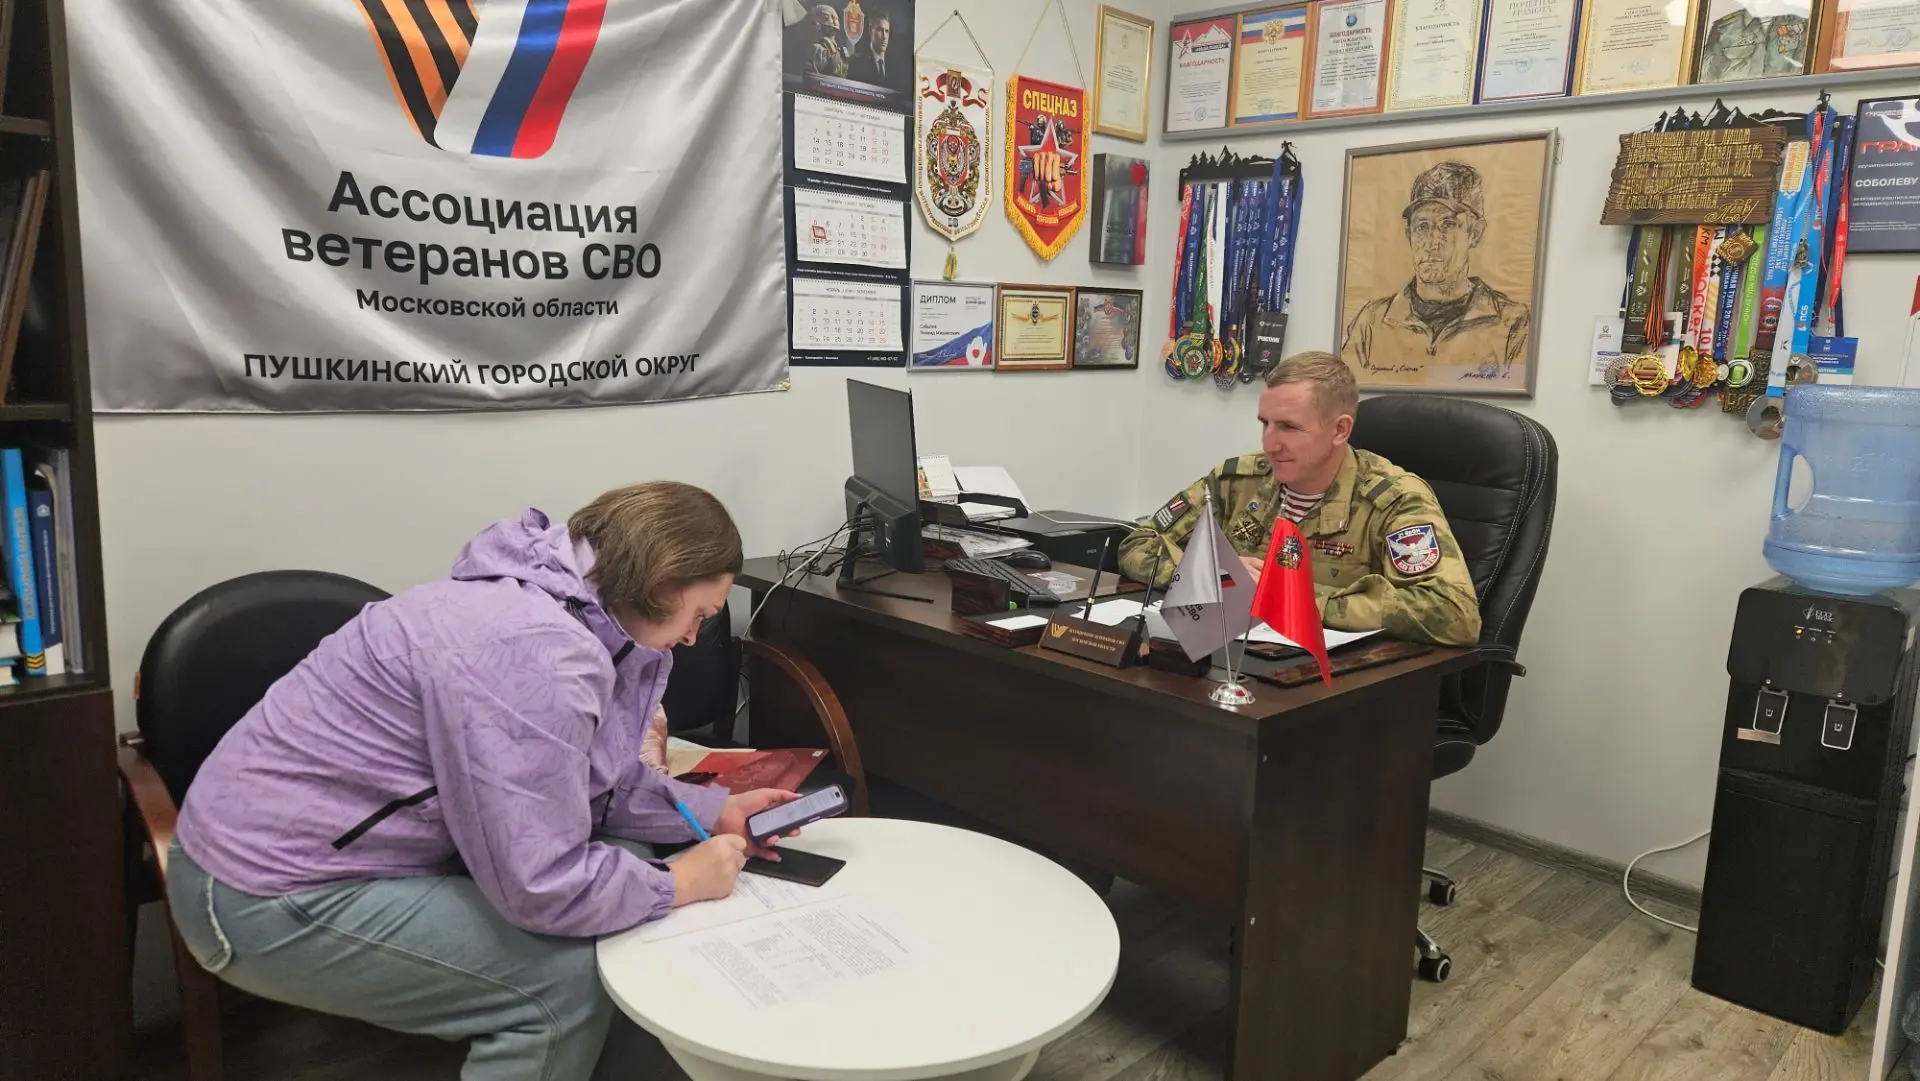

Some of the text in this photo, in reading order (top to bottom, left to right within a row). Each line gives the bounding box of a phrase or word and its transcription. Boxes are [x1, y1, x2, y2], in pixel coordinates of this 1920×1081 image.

[1180, 57, 1225, 68] БЛАГОДАРНОСТЬ
[1023, 89, 1078, 118] СПЕЦНАЗ
[1855, 176, 1919, 188] СОБОЛЕВУ
[327, 171, 638, 238] Ассоциация
[282, 228, 662, 285] ветеранов СВО
[356, 289, 619, 318] Московской области
[919, 294, 956, 305] ДИПЛОМ
[1729, 290, 1737, 309] ТУЛА
[1800, 304, 1808, 321] ПСБ
[1700, 327, 1713, 345] 10
[243, 353, 701, 388] ПУШКИНСКИЙ ГОРОДСКОЙ ОКРУГ
